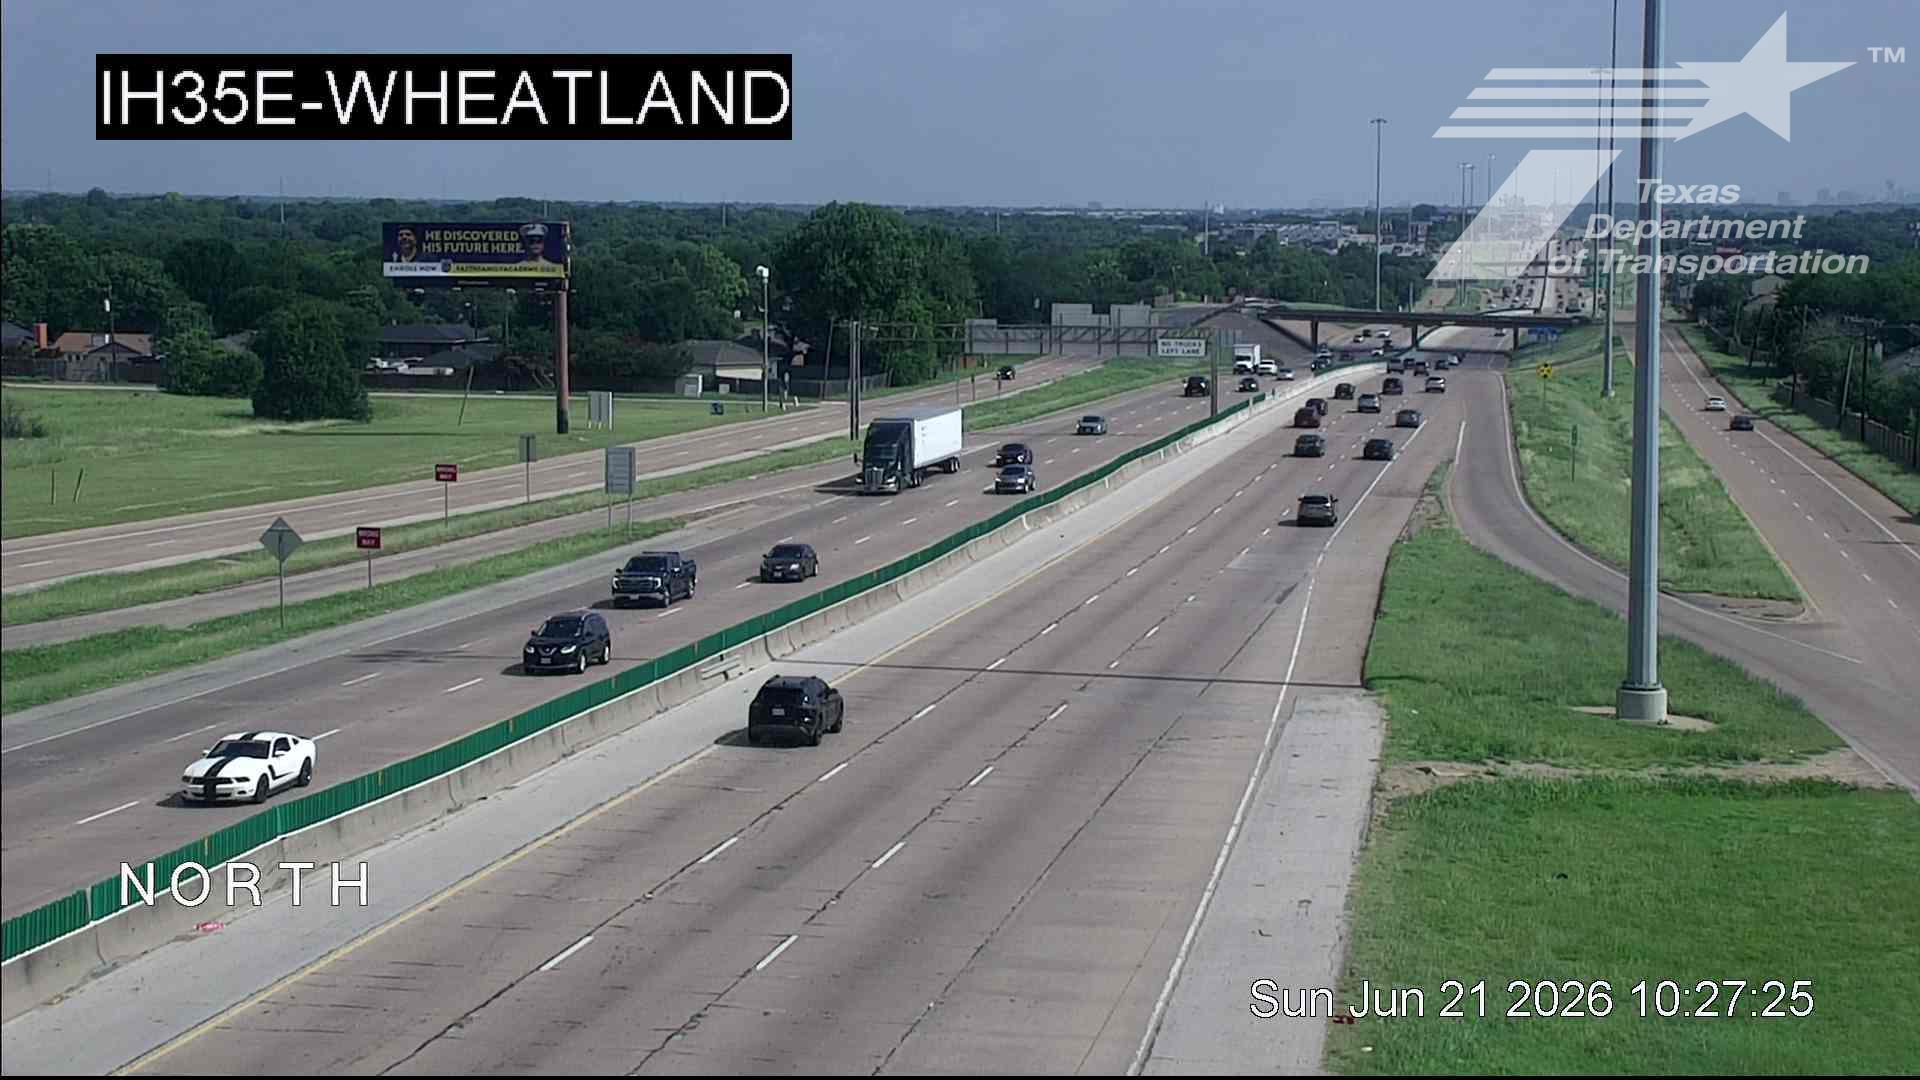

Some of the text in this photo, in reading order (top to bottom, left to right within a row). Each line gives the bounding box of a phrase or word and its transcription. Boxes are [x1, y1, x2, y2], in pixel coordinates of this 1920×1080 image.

[425, 230, 520, 241] HE DISCOVERED
[422, 242, 442, 253] HIS
[443, 242, 487, 253] FUTURE
